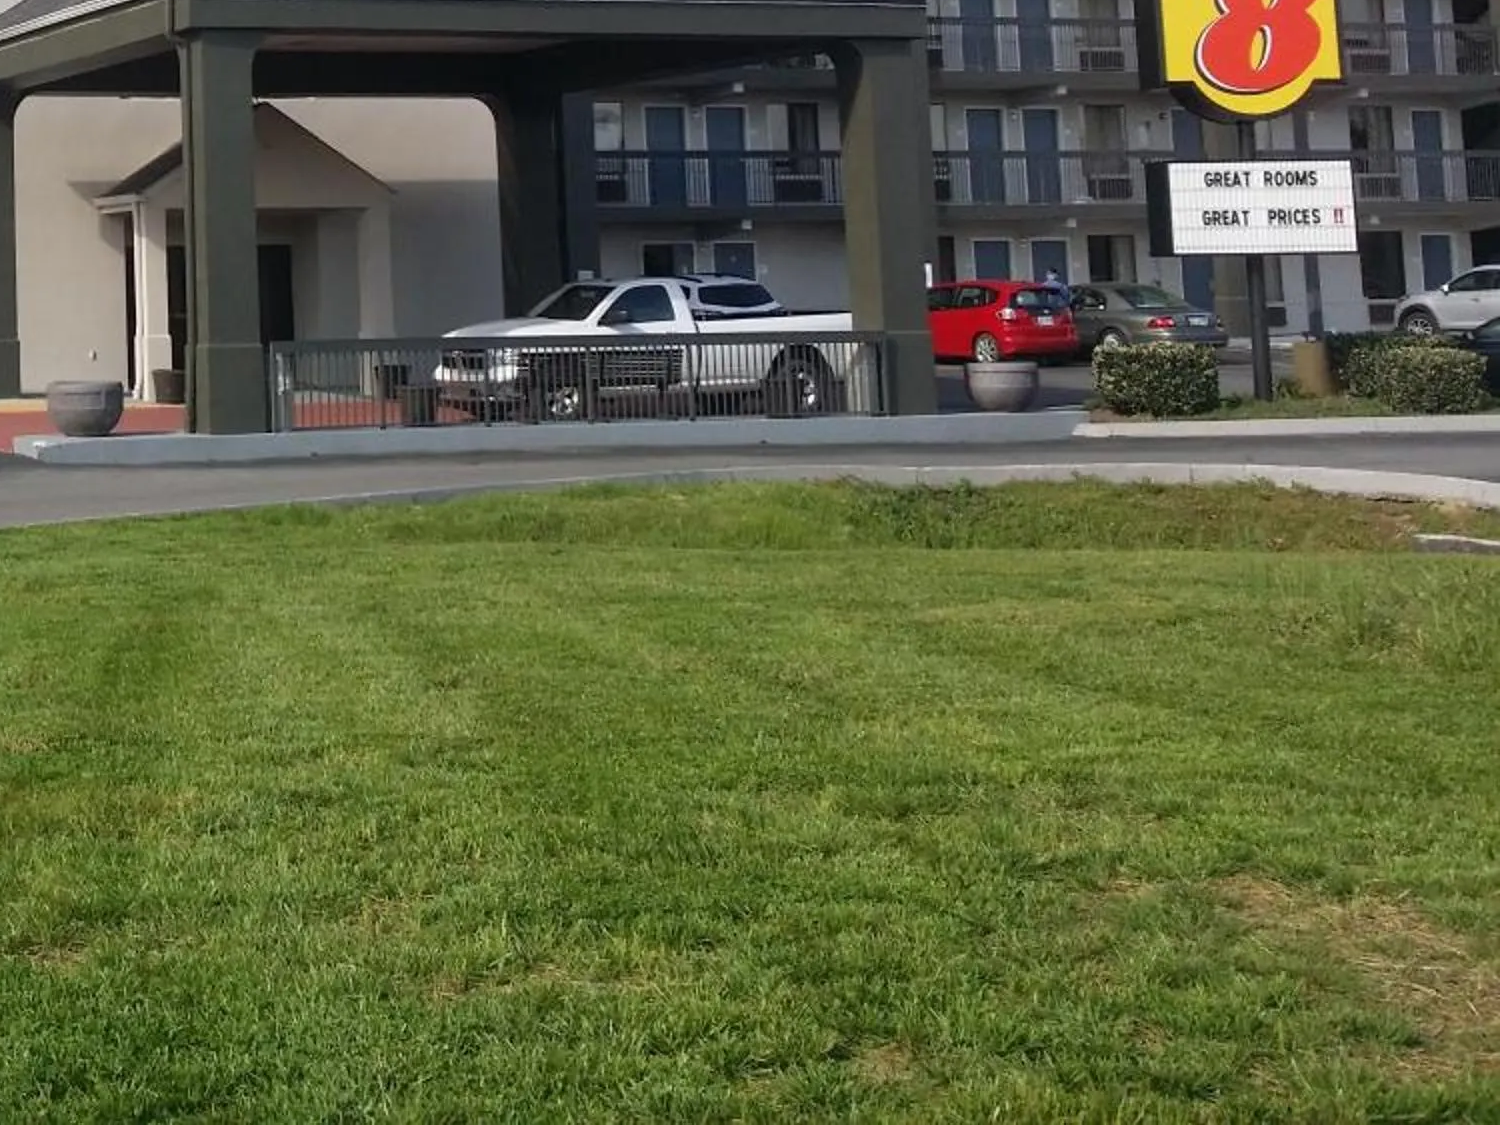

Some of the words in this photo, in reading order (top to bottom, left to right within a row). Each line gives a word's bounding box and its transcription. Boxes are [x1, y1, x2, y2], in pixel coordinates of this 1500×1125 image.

[1203, 171, 1251, 188] GREAT
[1263, 170, 1319, 187] ROOMS
[1202, 209, 1250, 226] GREAT
[1267, 208, 1321, 225] PRICES
